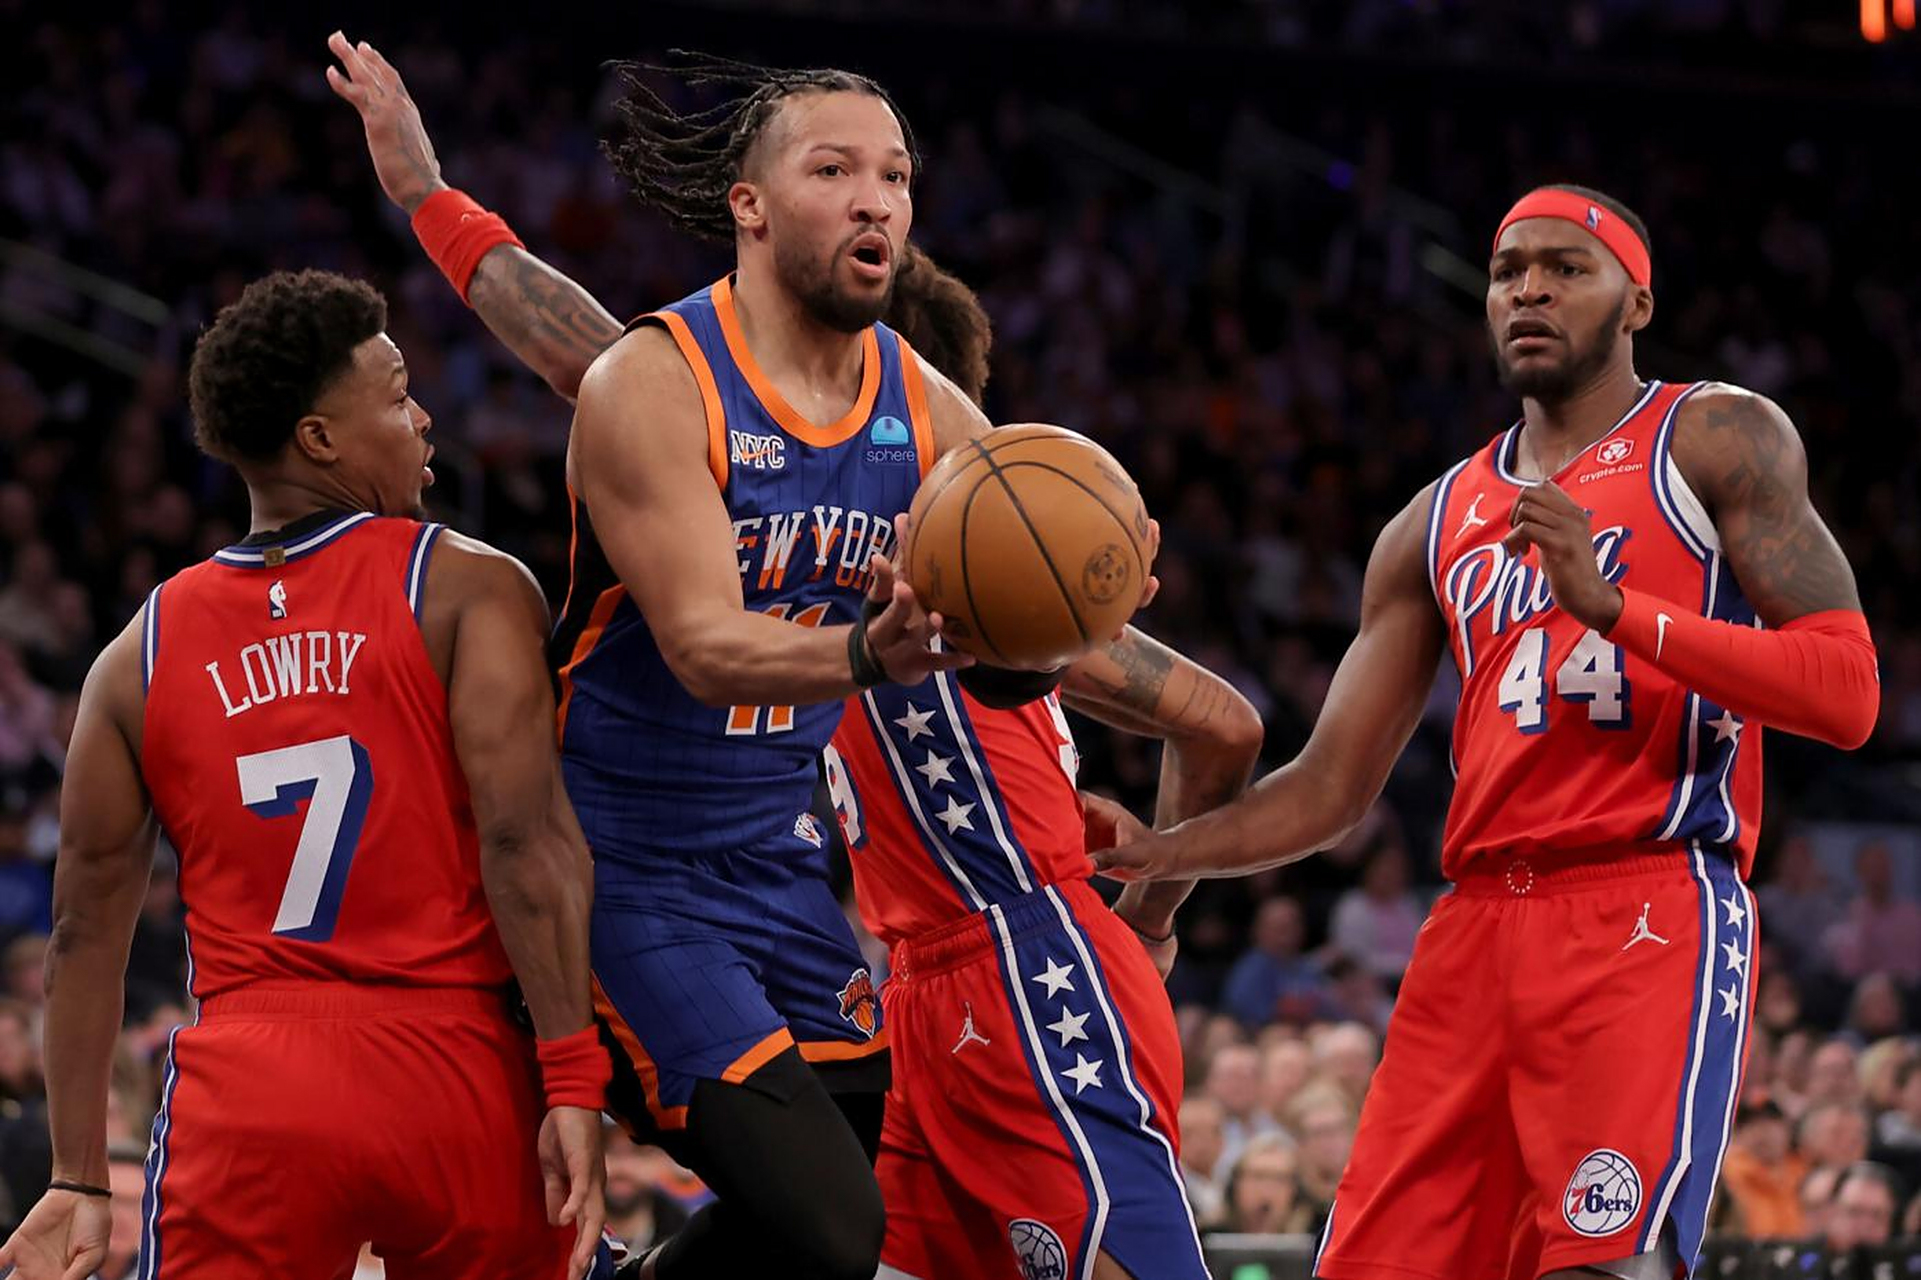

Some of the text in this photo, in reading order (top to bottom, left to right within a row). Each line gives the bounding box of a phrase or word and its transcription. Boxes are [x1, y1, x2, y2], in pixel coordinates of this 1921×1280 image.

[731, 430, 784, 468] NYC
[867, 448, 914, 463] sphere
[1580, 463, 1643, 484] crypto.com
[733, 505, 897, 590] EW YOR
[206, 631, 366, 718] LOWRY
[1498, 627, 1632, 735] 44
[236, 735, 374, 942] 7
[1570, 1184, 1633, 1214] 76ers
